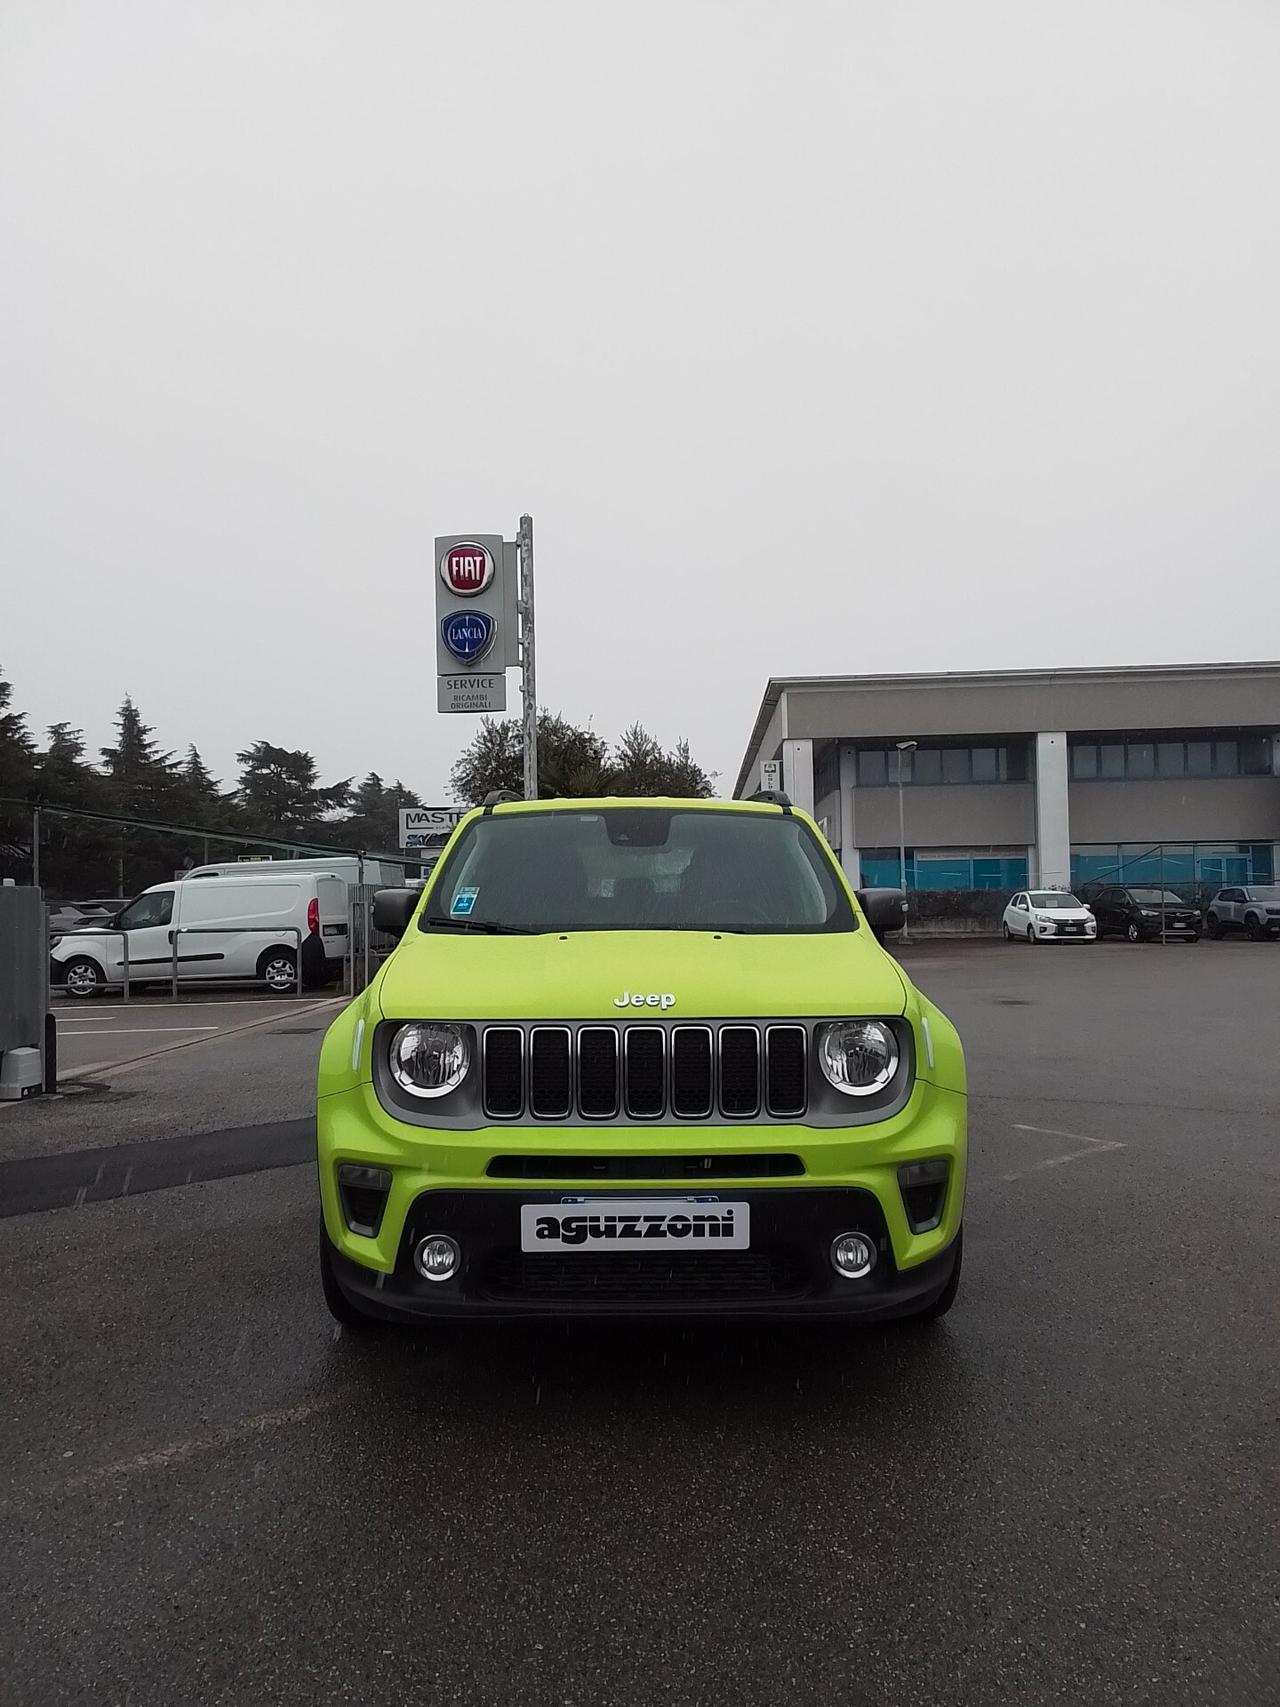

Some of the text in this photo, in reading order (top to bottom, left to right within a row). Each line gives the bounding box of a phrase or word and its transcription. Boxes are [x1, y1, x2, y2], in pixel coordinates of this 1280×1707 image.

[452, 556, 483, 580] FIAT
[452, 627, 482, 640] LANCIA
[446, 678, 495, 690] SERVICE
[453, 694, 488, 702] RICAMBI
[450, 701, 491, 710] ORIGINALI
[613, 992, 676, 1010] Jeep
[535, 1208, 735, 1245] aguzzoni
